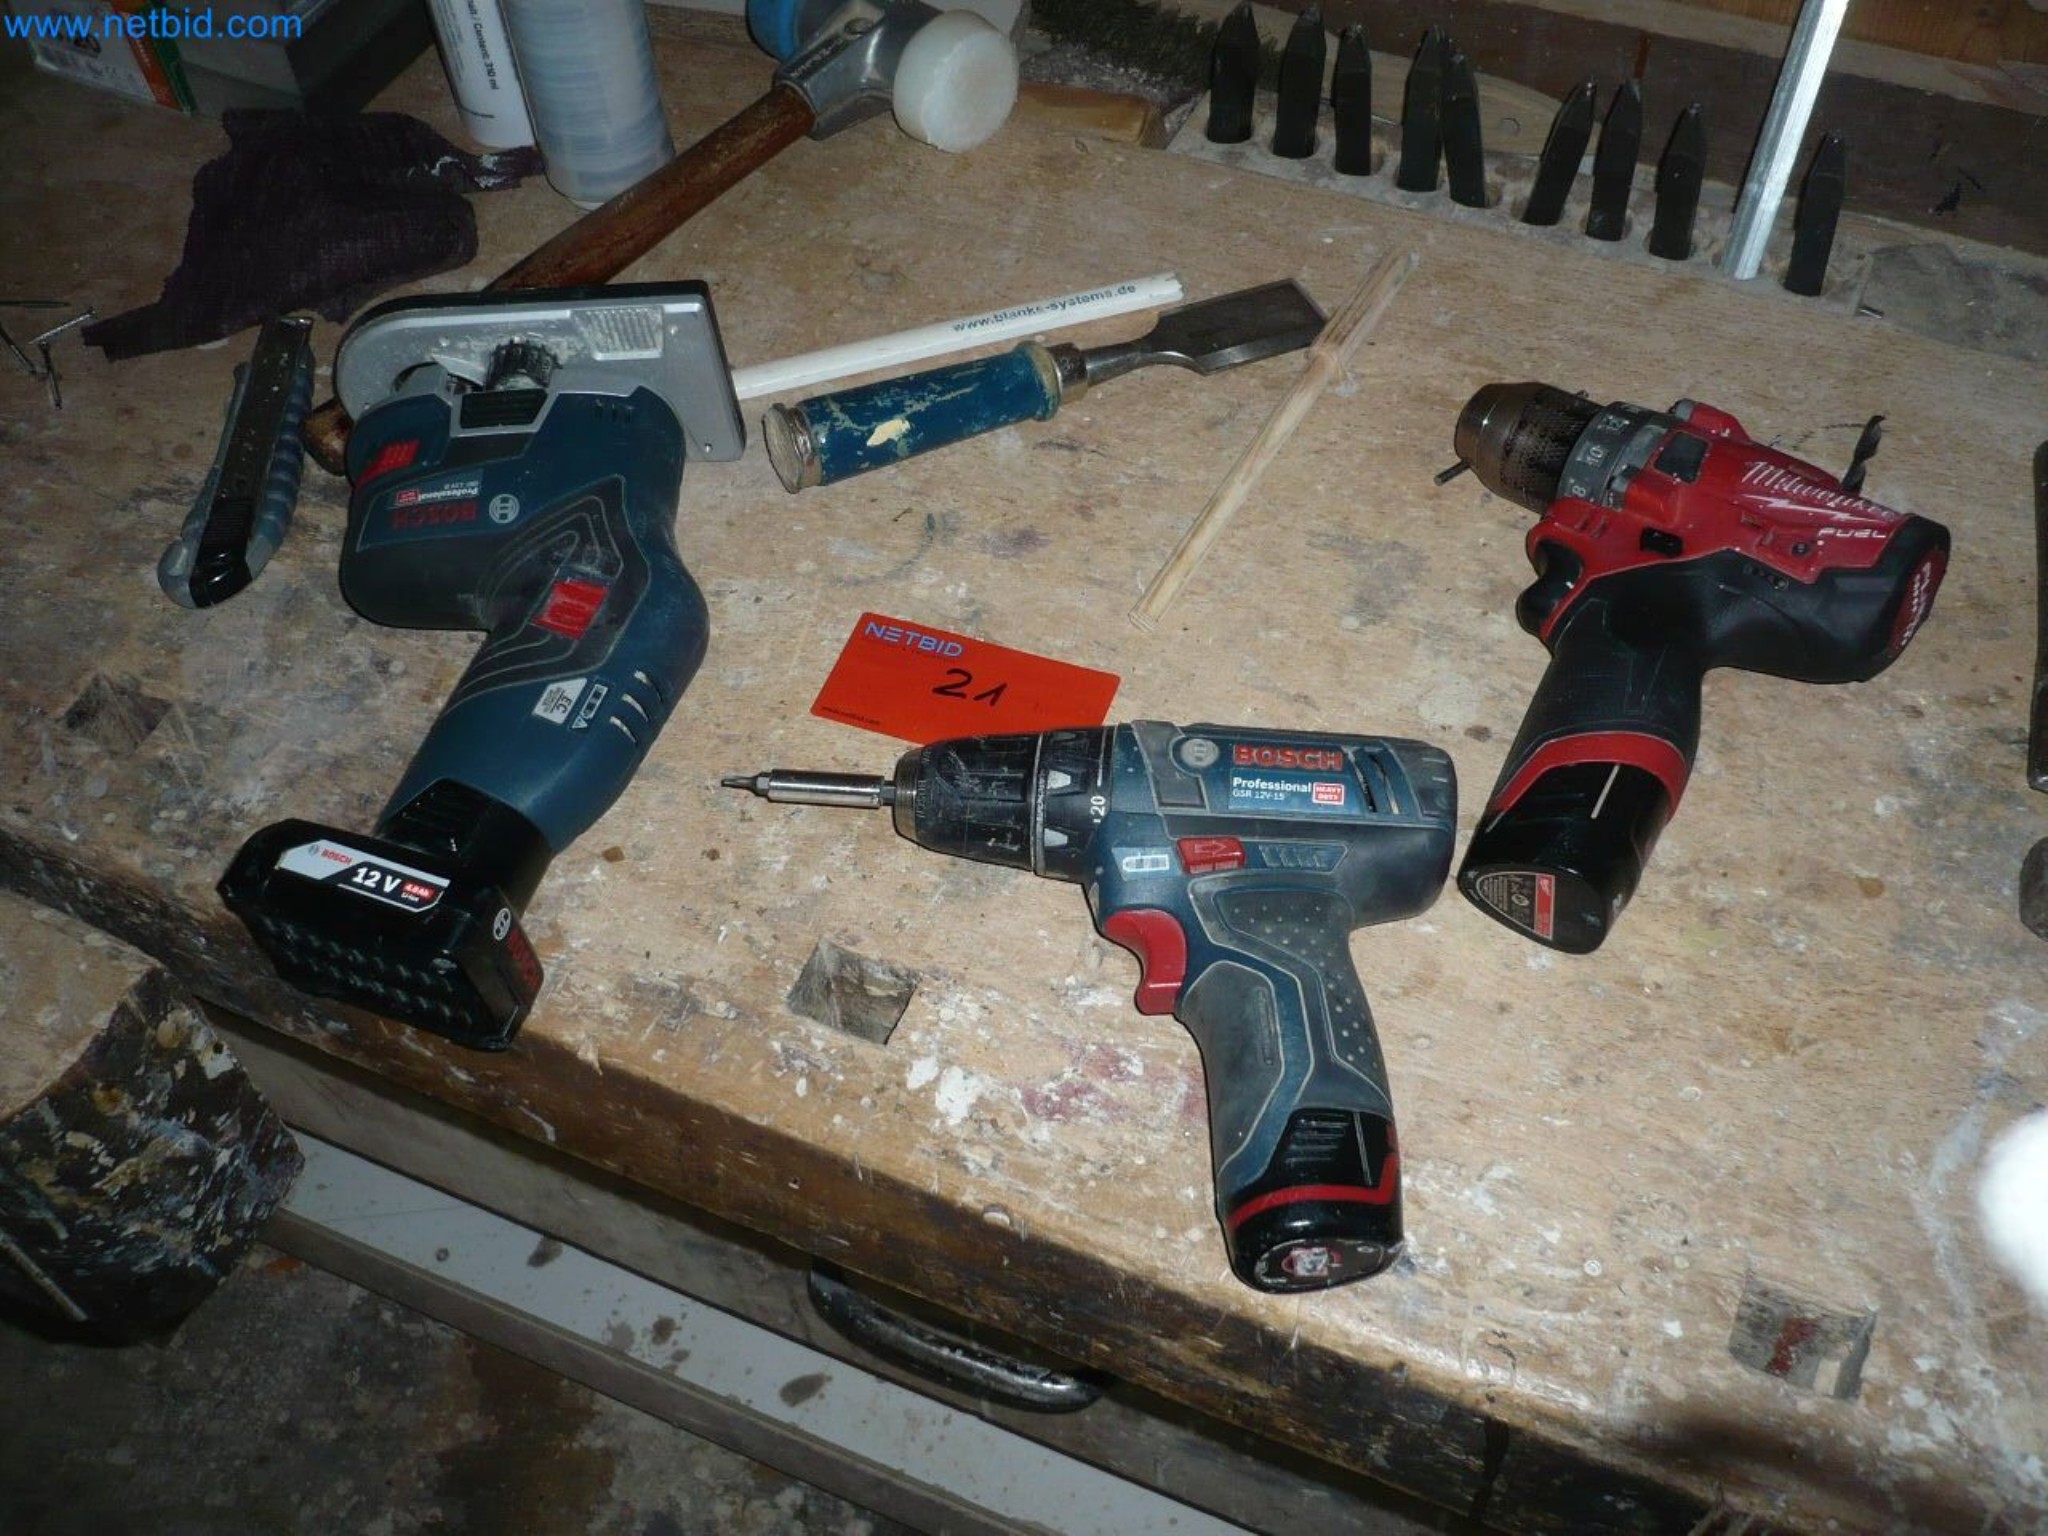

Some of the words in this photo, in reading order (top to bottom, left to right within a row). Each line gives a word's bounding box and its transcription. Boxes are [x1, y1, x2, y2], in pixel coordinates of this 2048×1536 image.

[1818, 527, 1887, 539] FUEL
[864, 621, 964, 658] NETBID
[931, 668, 1008, 707] 21
[1233, 744, 1343, 772] BOSCH
[1232, 777, 1312, 794] Professional
[1089, 795, 1106, 817] 20
[320, 848, 353, 865] BOSCH
[352, 866, 382, 888] 12
[383, 875, 402, 893] V
